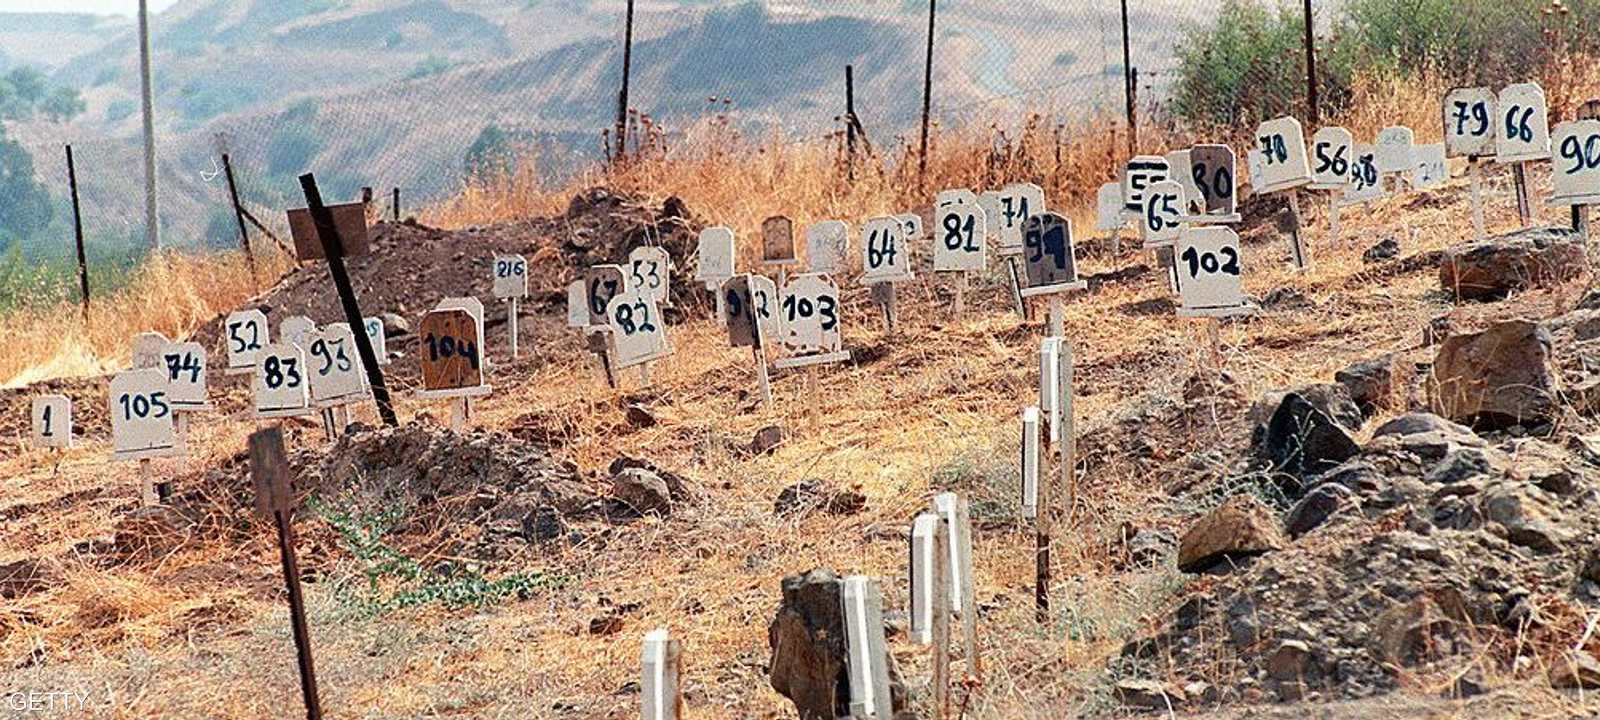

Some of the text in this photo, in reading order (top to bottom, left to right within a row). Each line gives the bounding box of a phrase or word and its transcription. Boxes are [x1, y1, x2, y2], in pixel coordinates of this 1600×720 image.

[1453, 101, 1488, 136] 79
[1505, 105, 1534, 143] 66
[1259, 133, 1287, 165] 70
[1316, 142, 1348, 176] 56
[1561, 134, 1600, 174] 90
[1001, 196, 1029, 227] 71
[1148, 193, 1179, 231] 65
[868, 229, 896, 268] 64
[943, 213, 979, 253] 81
[497, 261, 524, 278] 216
[631, 260, 660, 289] 53
[1182, 246, 1240, 279] 102
[591, 277, 617, 316] 67
[783, 295, 837, 330] 103
[615, 298, 655, 336] 82
[228, 320, 262, 353] 52
[425, 333, 479, 369] 104
[165, 352, 202, 384] 74
[264, 355, 302, 389] 83
[310, 338, 352, 376] 93
[41, 405, 53, 437] 1
[119, 391, 170, 421] 105
